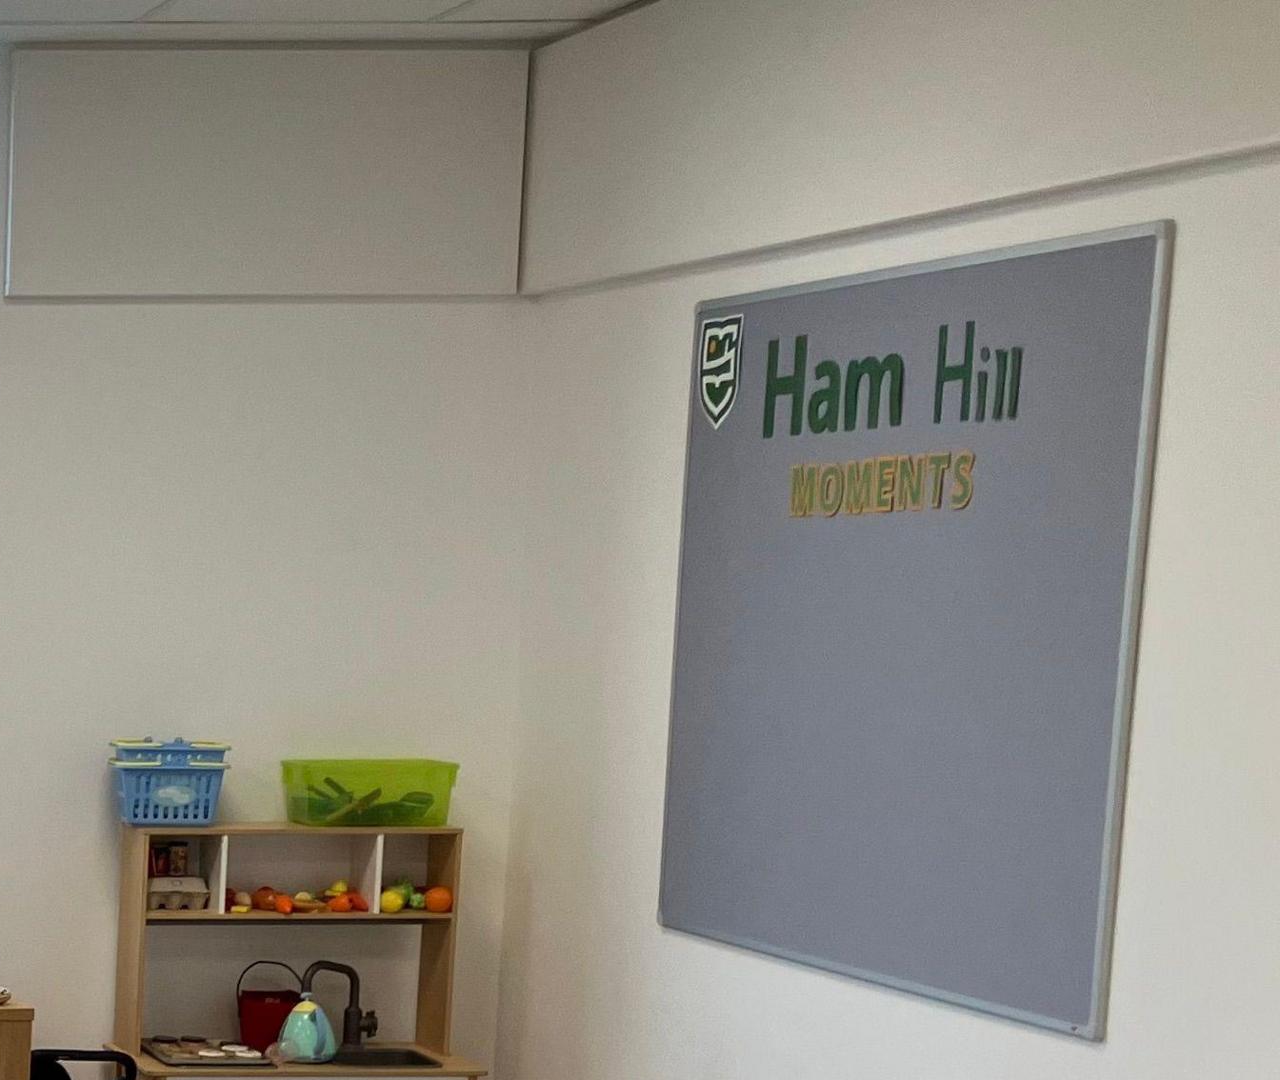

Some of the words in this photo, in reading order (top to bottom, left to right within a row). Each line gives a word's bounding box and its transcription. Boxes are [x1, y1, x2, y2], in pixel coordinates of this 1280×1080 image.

[762, 333, 905, 439] Ham
[933, 320, 1024, 424] Hill
[788, 449, 976, 518] MOMENTS
